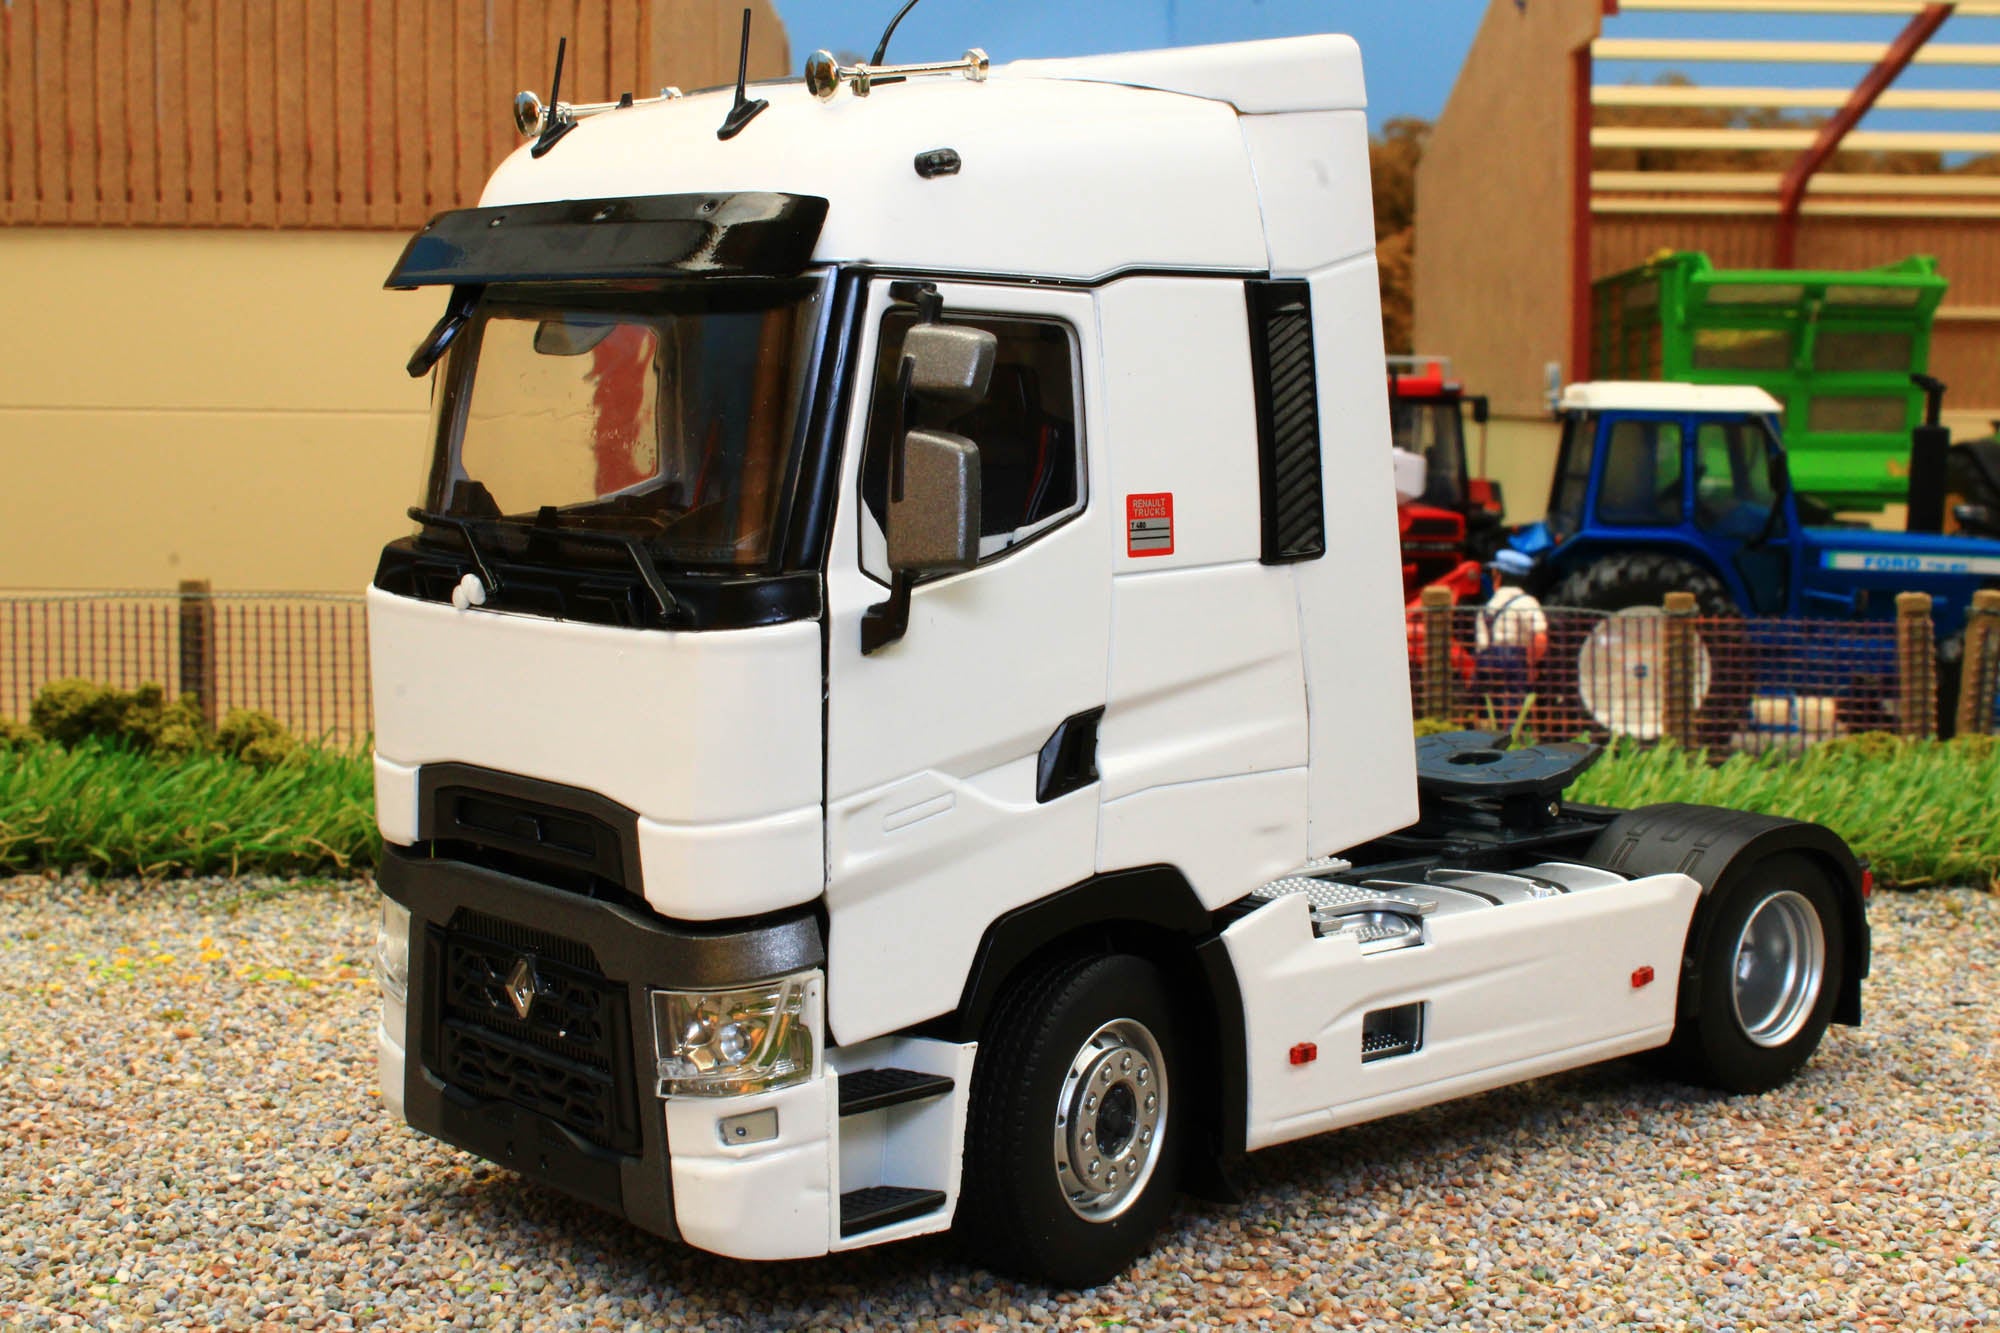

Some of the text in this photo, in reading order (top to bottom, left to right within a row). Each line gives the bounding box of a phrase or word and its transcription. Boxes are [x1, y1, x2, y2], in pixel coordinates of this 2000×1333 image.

[1132, 498, 1166, 507] RENAULT
[1133, 507, 1166, 517] TRUCKS
[1864, 555, 1921, 571] FORD
